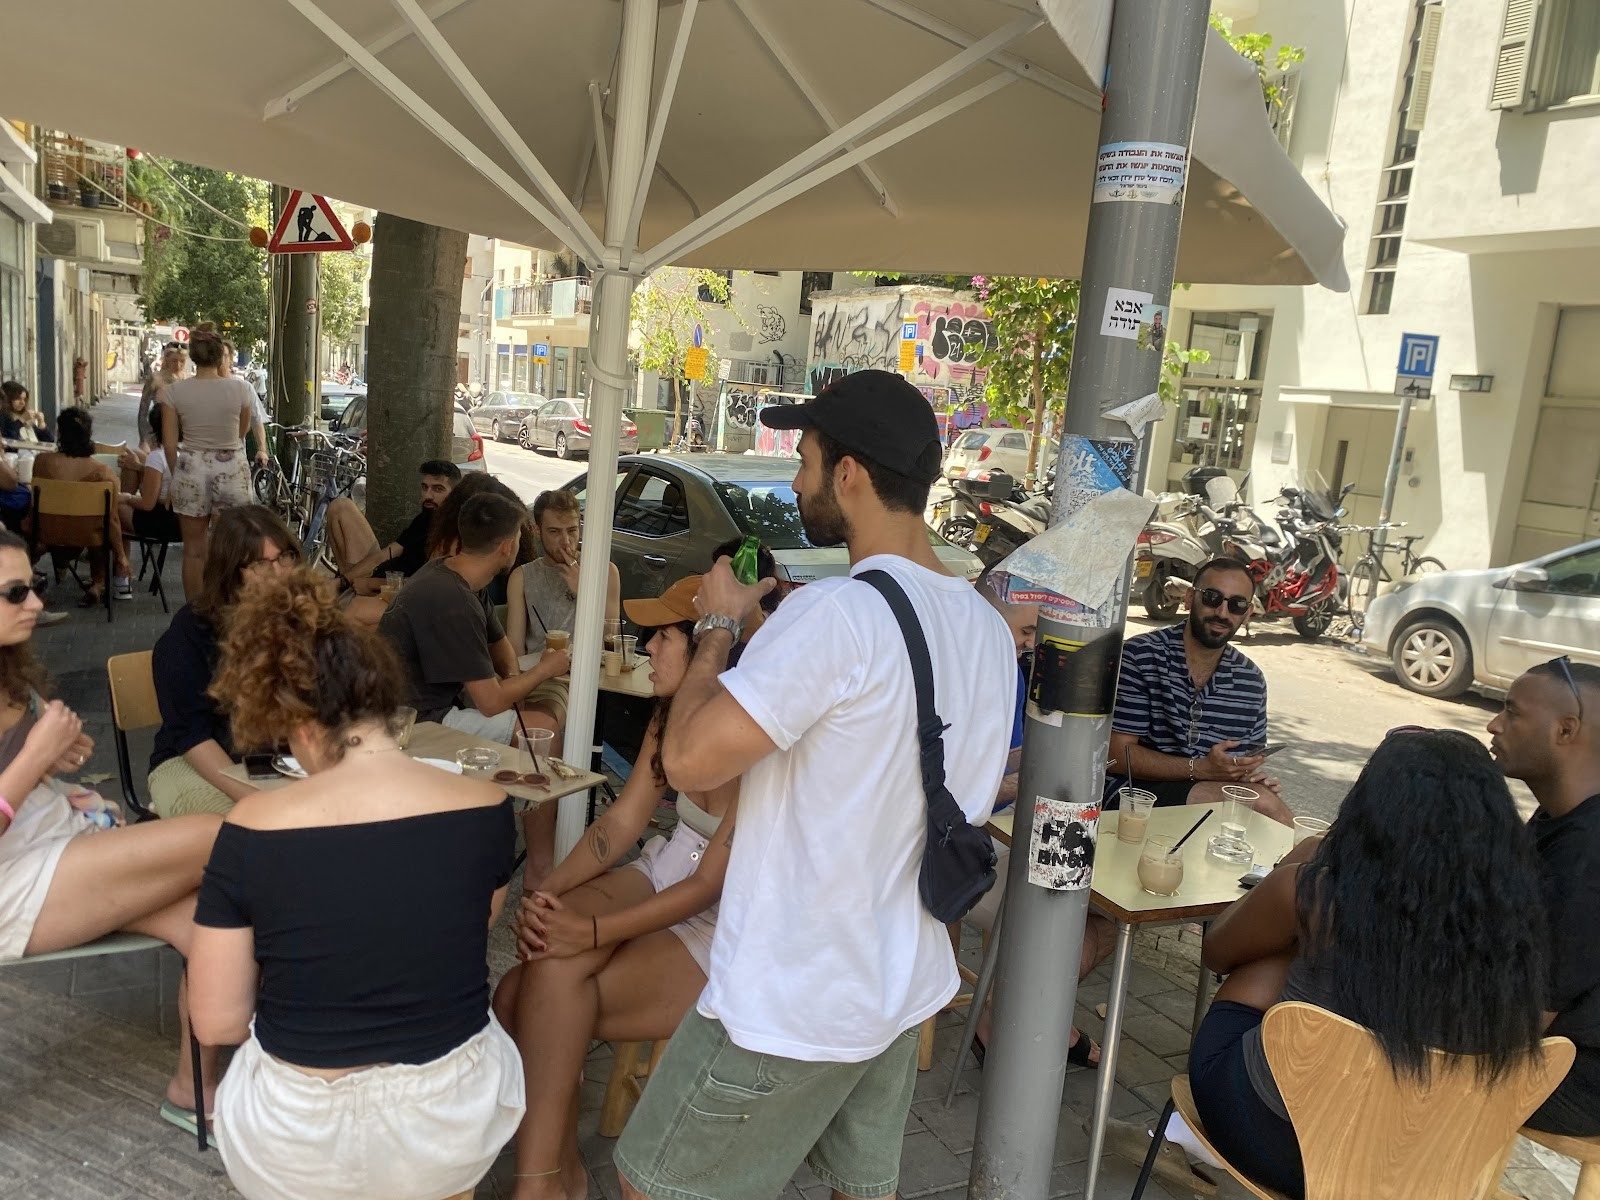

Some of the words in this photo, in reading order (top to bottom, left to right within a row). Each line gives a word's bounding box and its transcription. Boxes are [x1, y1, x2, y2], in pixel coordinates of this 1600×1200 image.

[1118, 149, 1148, 158] העבודה
[1150, 149, 1162, 158] את
[1115, 162, 1128, 170] את
[1147, 174, 1158, 182] של
[1114, 300, 1143, 314] אבא
